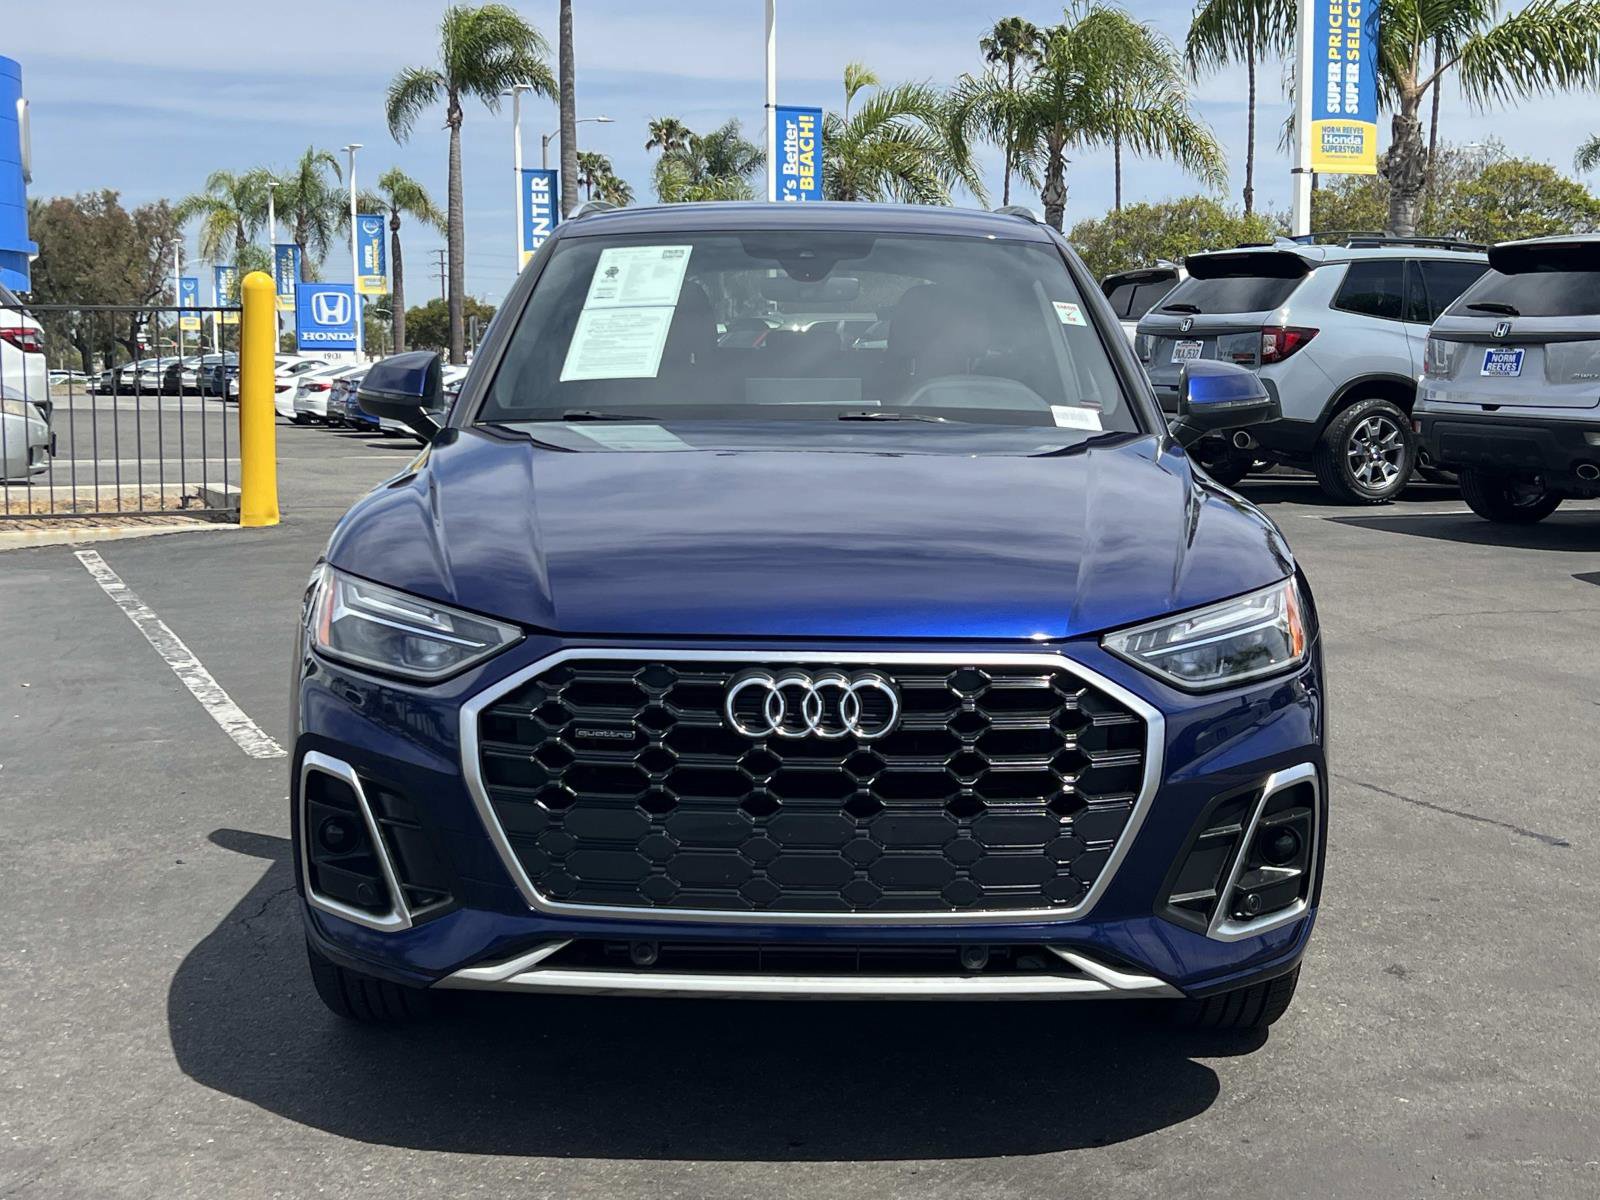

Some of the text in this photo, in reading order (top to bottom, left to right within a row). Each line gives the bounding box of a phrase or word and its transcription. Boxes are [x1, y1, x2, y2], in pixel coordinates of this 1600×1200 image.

[1327, 62, 1342, 114] SUPER
[1345, 63, 1360, 114] SUPER
[1322, 126, 1341, 134] NORM
[1324, 134, 1362, 145] Honda
[783, 120, 799, 175] Better
[1321, 145, 1363, 154] SUPERSTORE
[799, 115, 815, 191] BEACH!
[1491, 354, 1516, 363] NORM
[1486, 362, 1517, 372] REEVES
[577, 730, 633, 739] quattro
